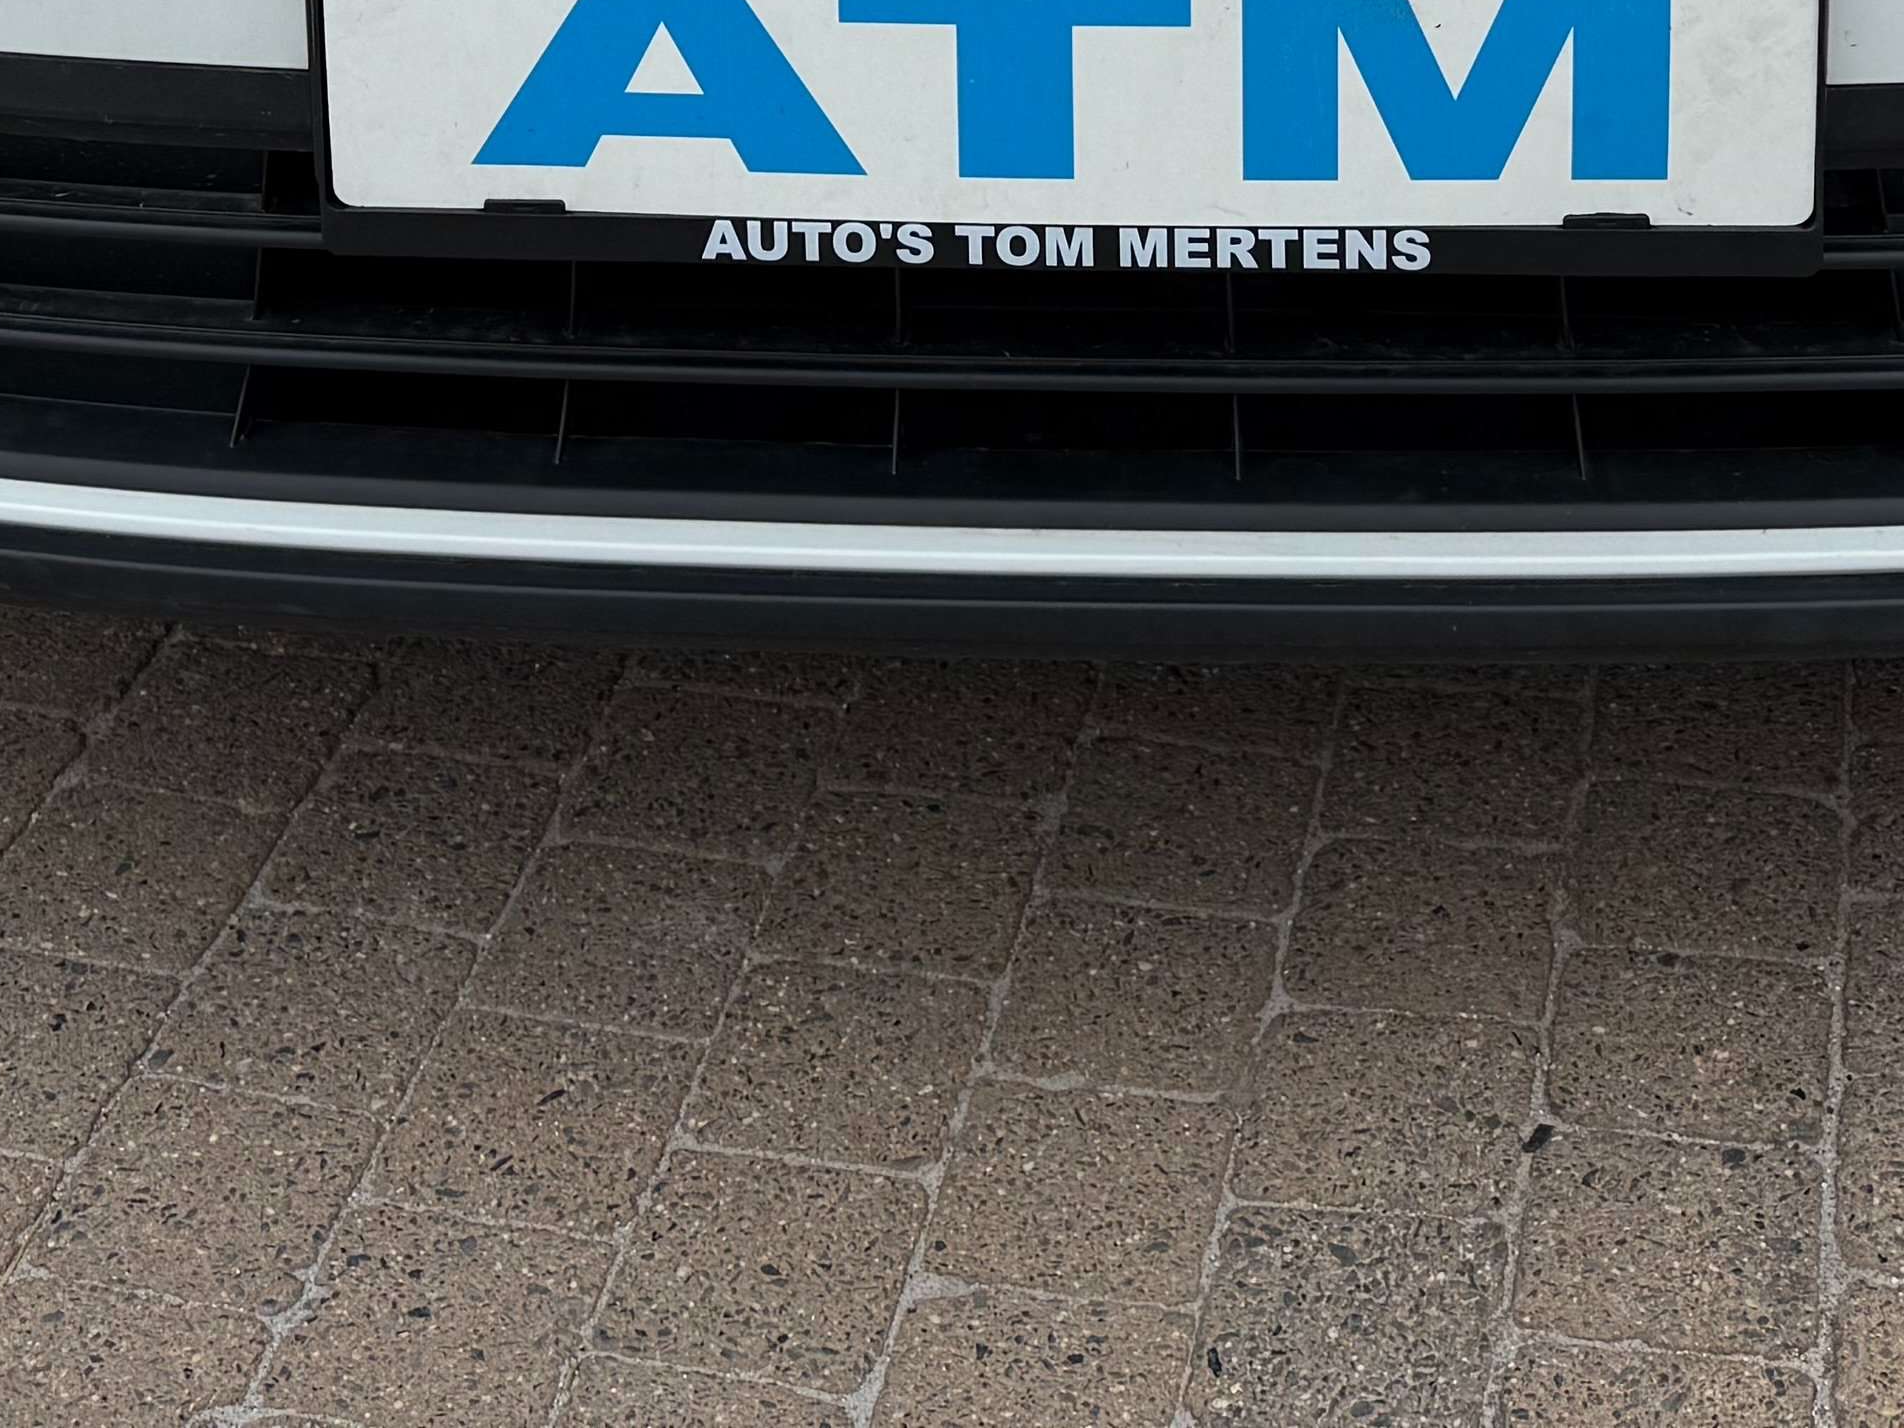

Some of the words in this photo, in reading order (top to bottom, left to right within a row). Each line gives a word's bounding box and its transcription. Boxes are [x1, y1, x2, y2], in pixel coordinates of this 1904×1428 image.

[701, 219, 935, 264] AUTO'S
[954, 223, 1095, 268] TOM
[1118, 226, 1432, 271] MERTENS
